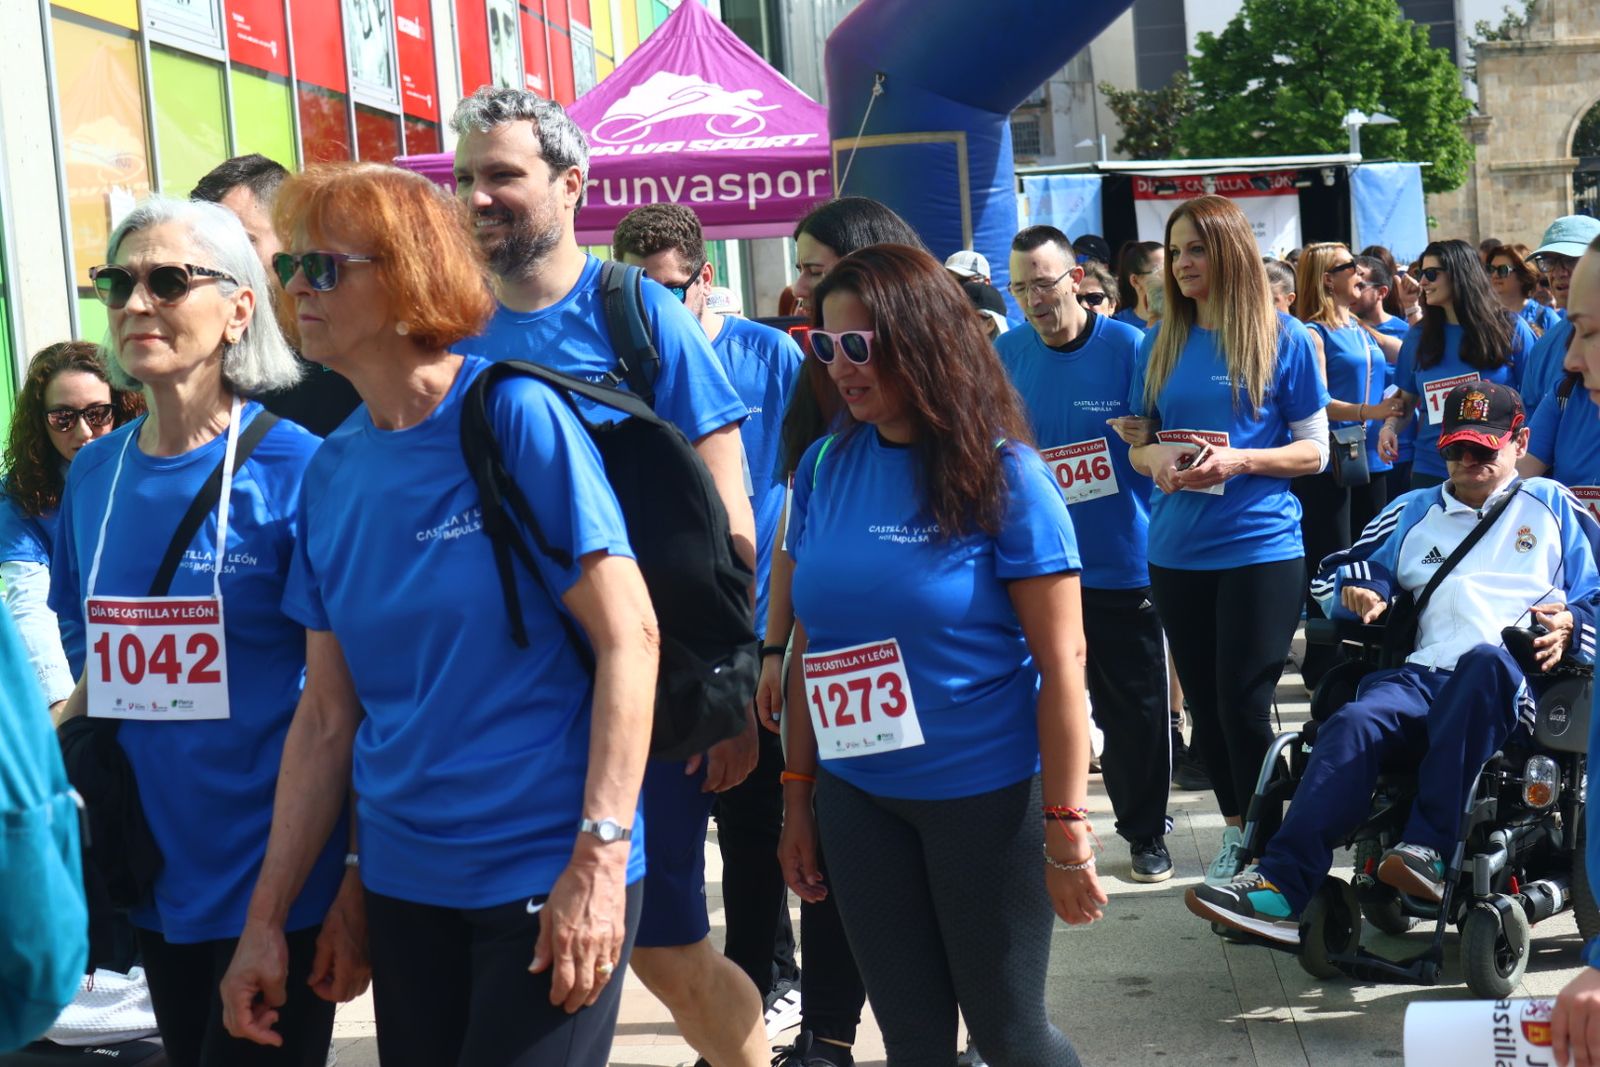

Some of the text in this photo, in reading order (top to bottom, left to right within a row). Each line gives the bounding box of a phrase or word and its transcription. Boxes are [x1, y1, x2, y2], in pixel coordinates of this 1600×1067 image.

[589, 133, 819, 157] UN VA SPORT
[582, 168, 832, 210] runvaspor
[1185, 178, 1246, 193] CATILLA
[1052, 456, 1111, 489] 046
[227, 554, 257, 565] LEÓN
[91, 605, 214, 619] DÍA DE CASTILLA Y LEÓN
[94, 632, 221, 685] 1042
[815, 663, 822, 671] DE
[822, 657, 859, 673] CASTILLA
[868, 649, 894, 662] LEÓN
[812, 671, 908, 729] 1273
